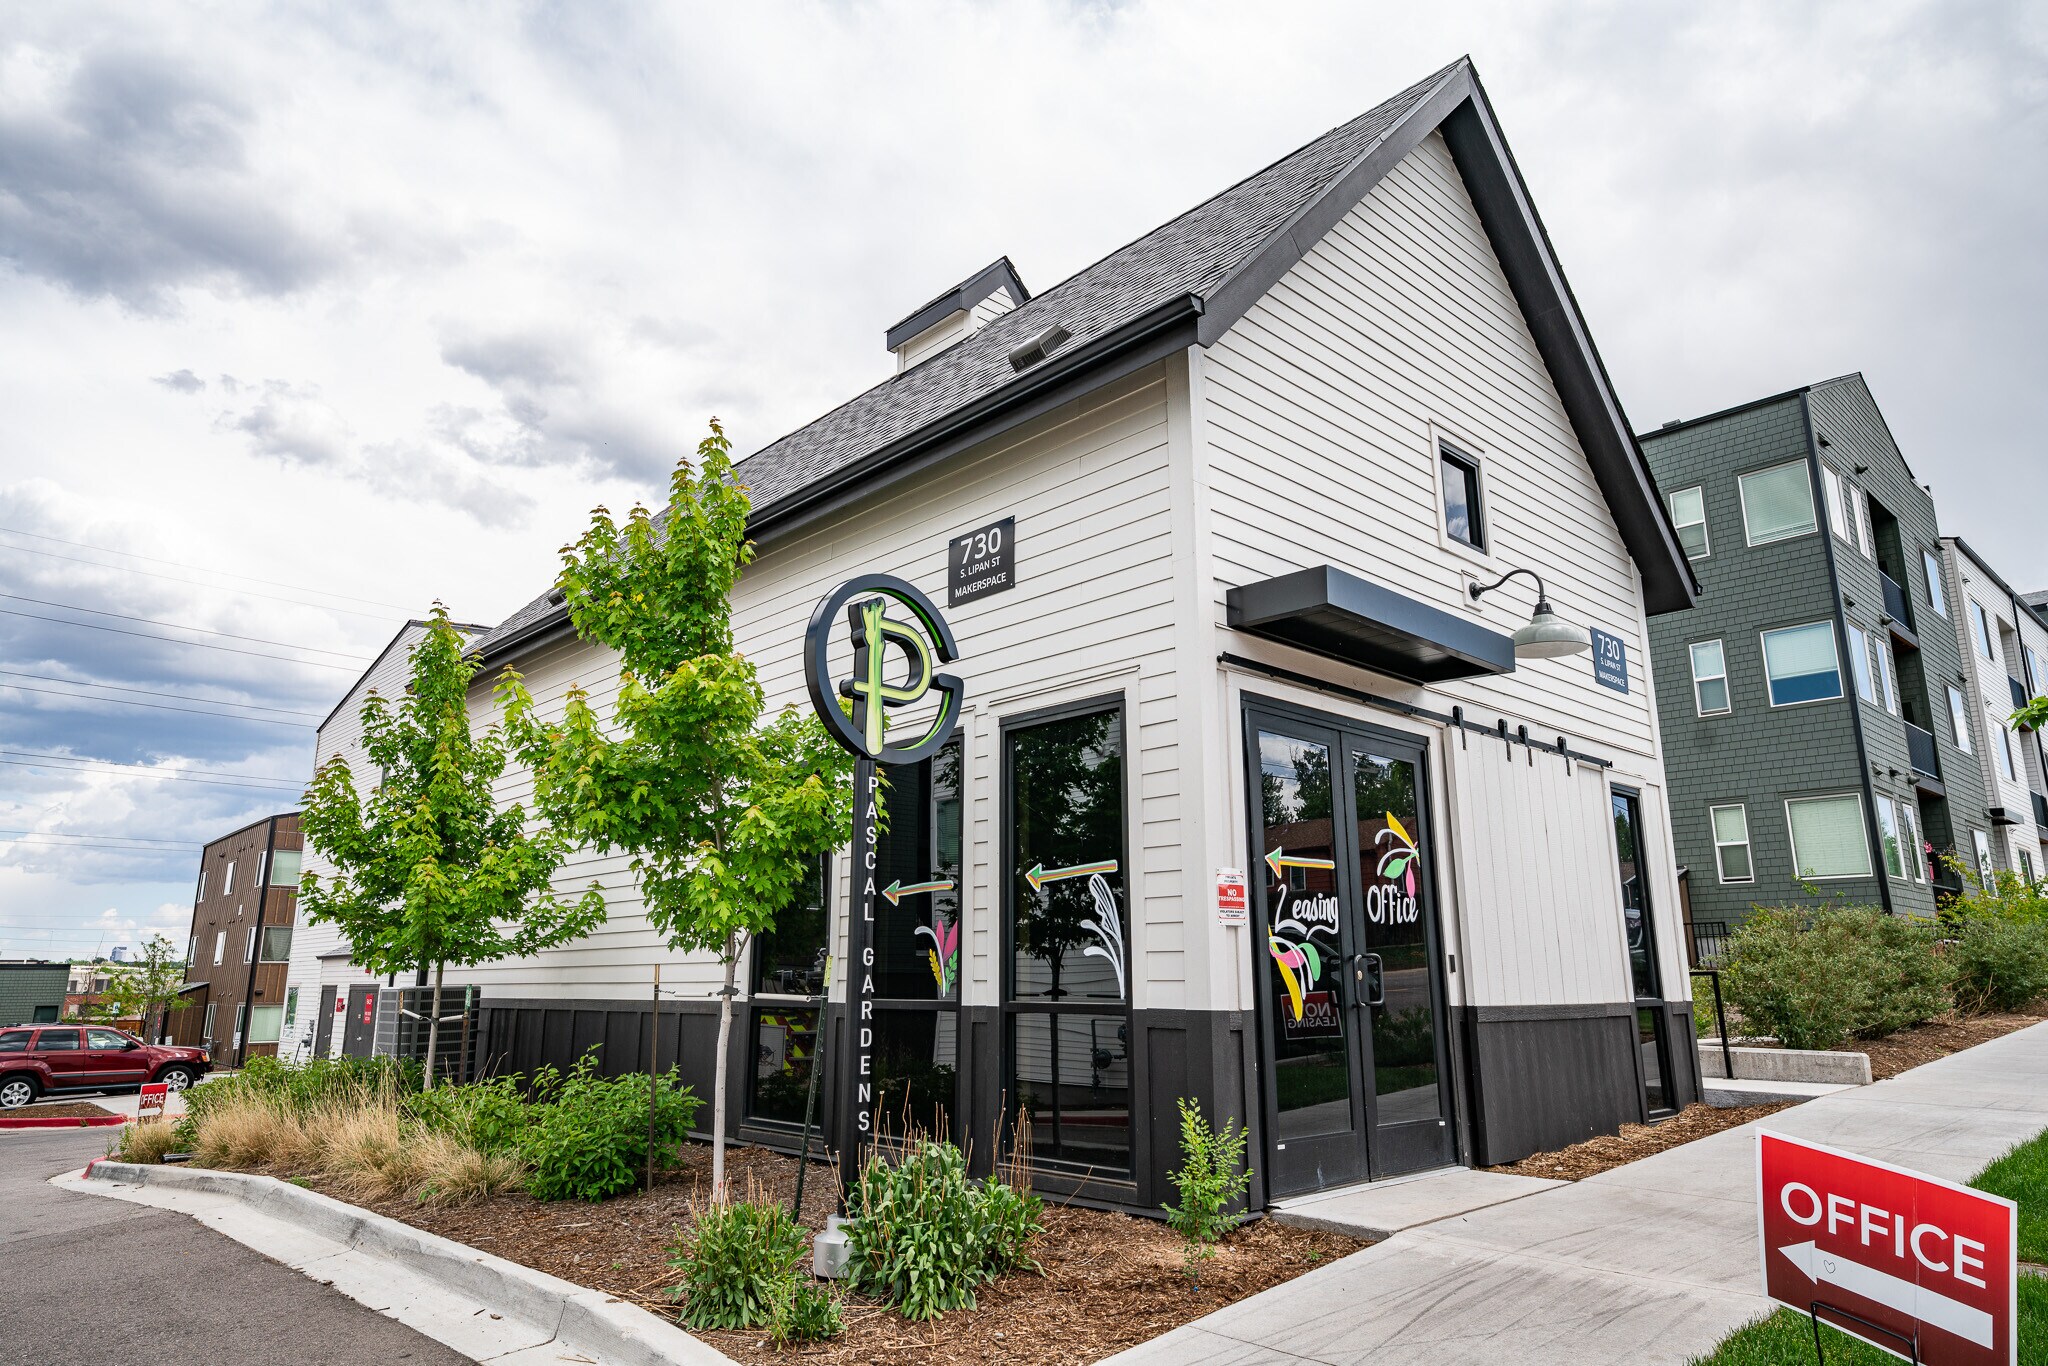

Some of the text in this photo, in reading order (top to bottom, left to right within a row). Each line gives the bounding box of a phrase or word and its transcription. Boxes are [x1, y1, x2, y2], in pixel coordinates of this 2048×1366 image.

[961, 528, 1001, 564] 730
[960, 556, 1001, 579] S. LIPAN ST
[955, 572, 1007, 598] MAKERSPACE
[1597, 633, 1620, 661] 730
[1227, 888, 1237, 897] NO
[1275, 884, 1419, 941] Leasing Office
[858, 776, 879, 1132] PASCAL GARDENS
[140, 1092, 165, 1105] OFFICE
[1780, 1181, 1987, 1290] OFFICE
